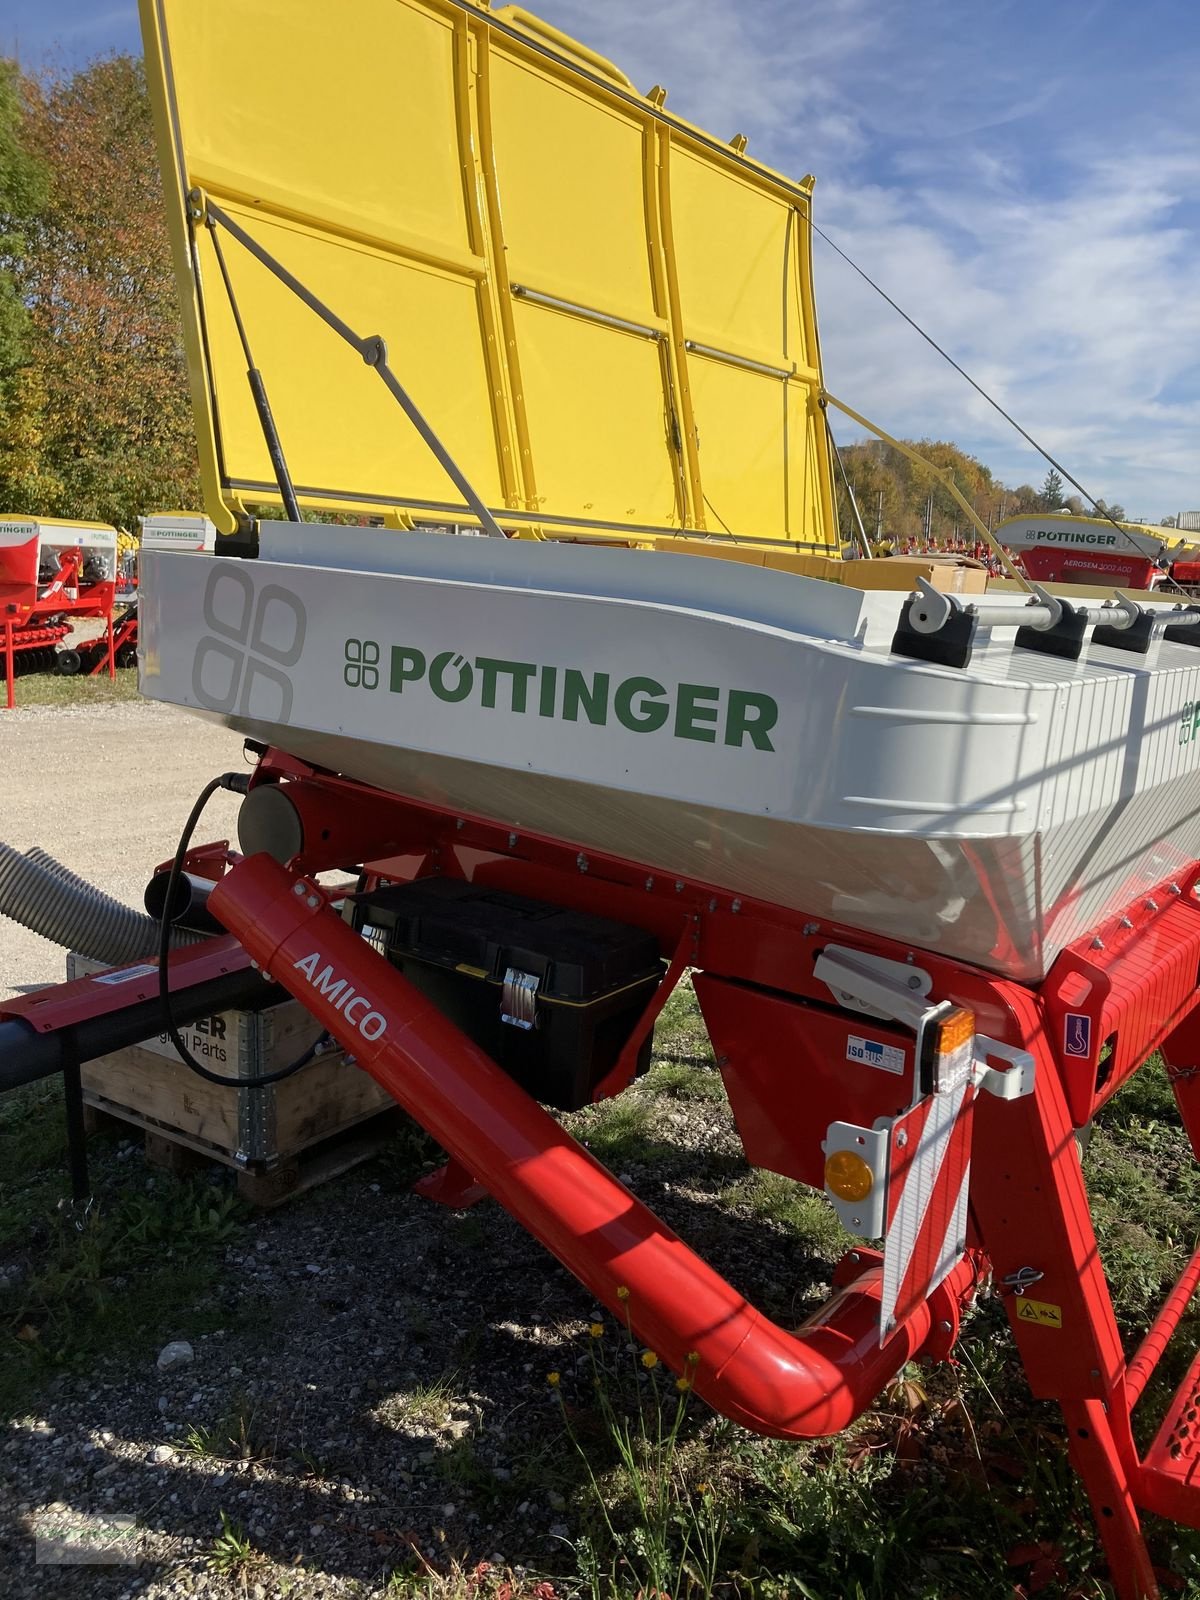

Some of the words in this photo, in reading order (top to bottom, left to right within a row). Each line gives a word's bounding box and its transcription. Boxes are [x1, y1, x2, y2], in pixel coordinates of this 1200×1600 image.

[1037, 531, 1117, 545] PÖTTINGER
[1063, 559, 1098, 569] AEROSEM
[389, 645, 778, 752] PÖTTINGER
[293, 952, 387, 1041] AMICO
[193, 1034, 227, 1062] Parts
